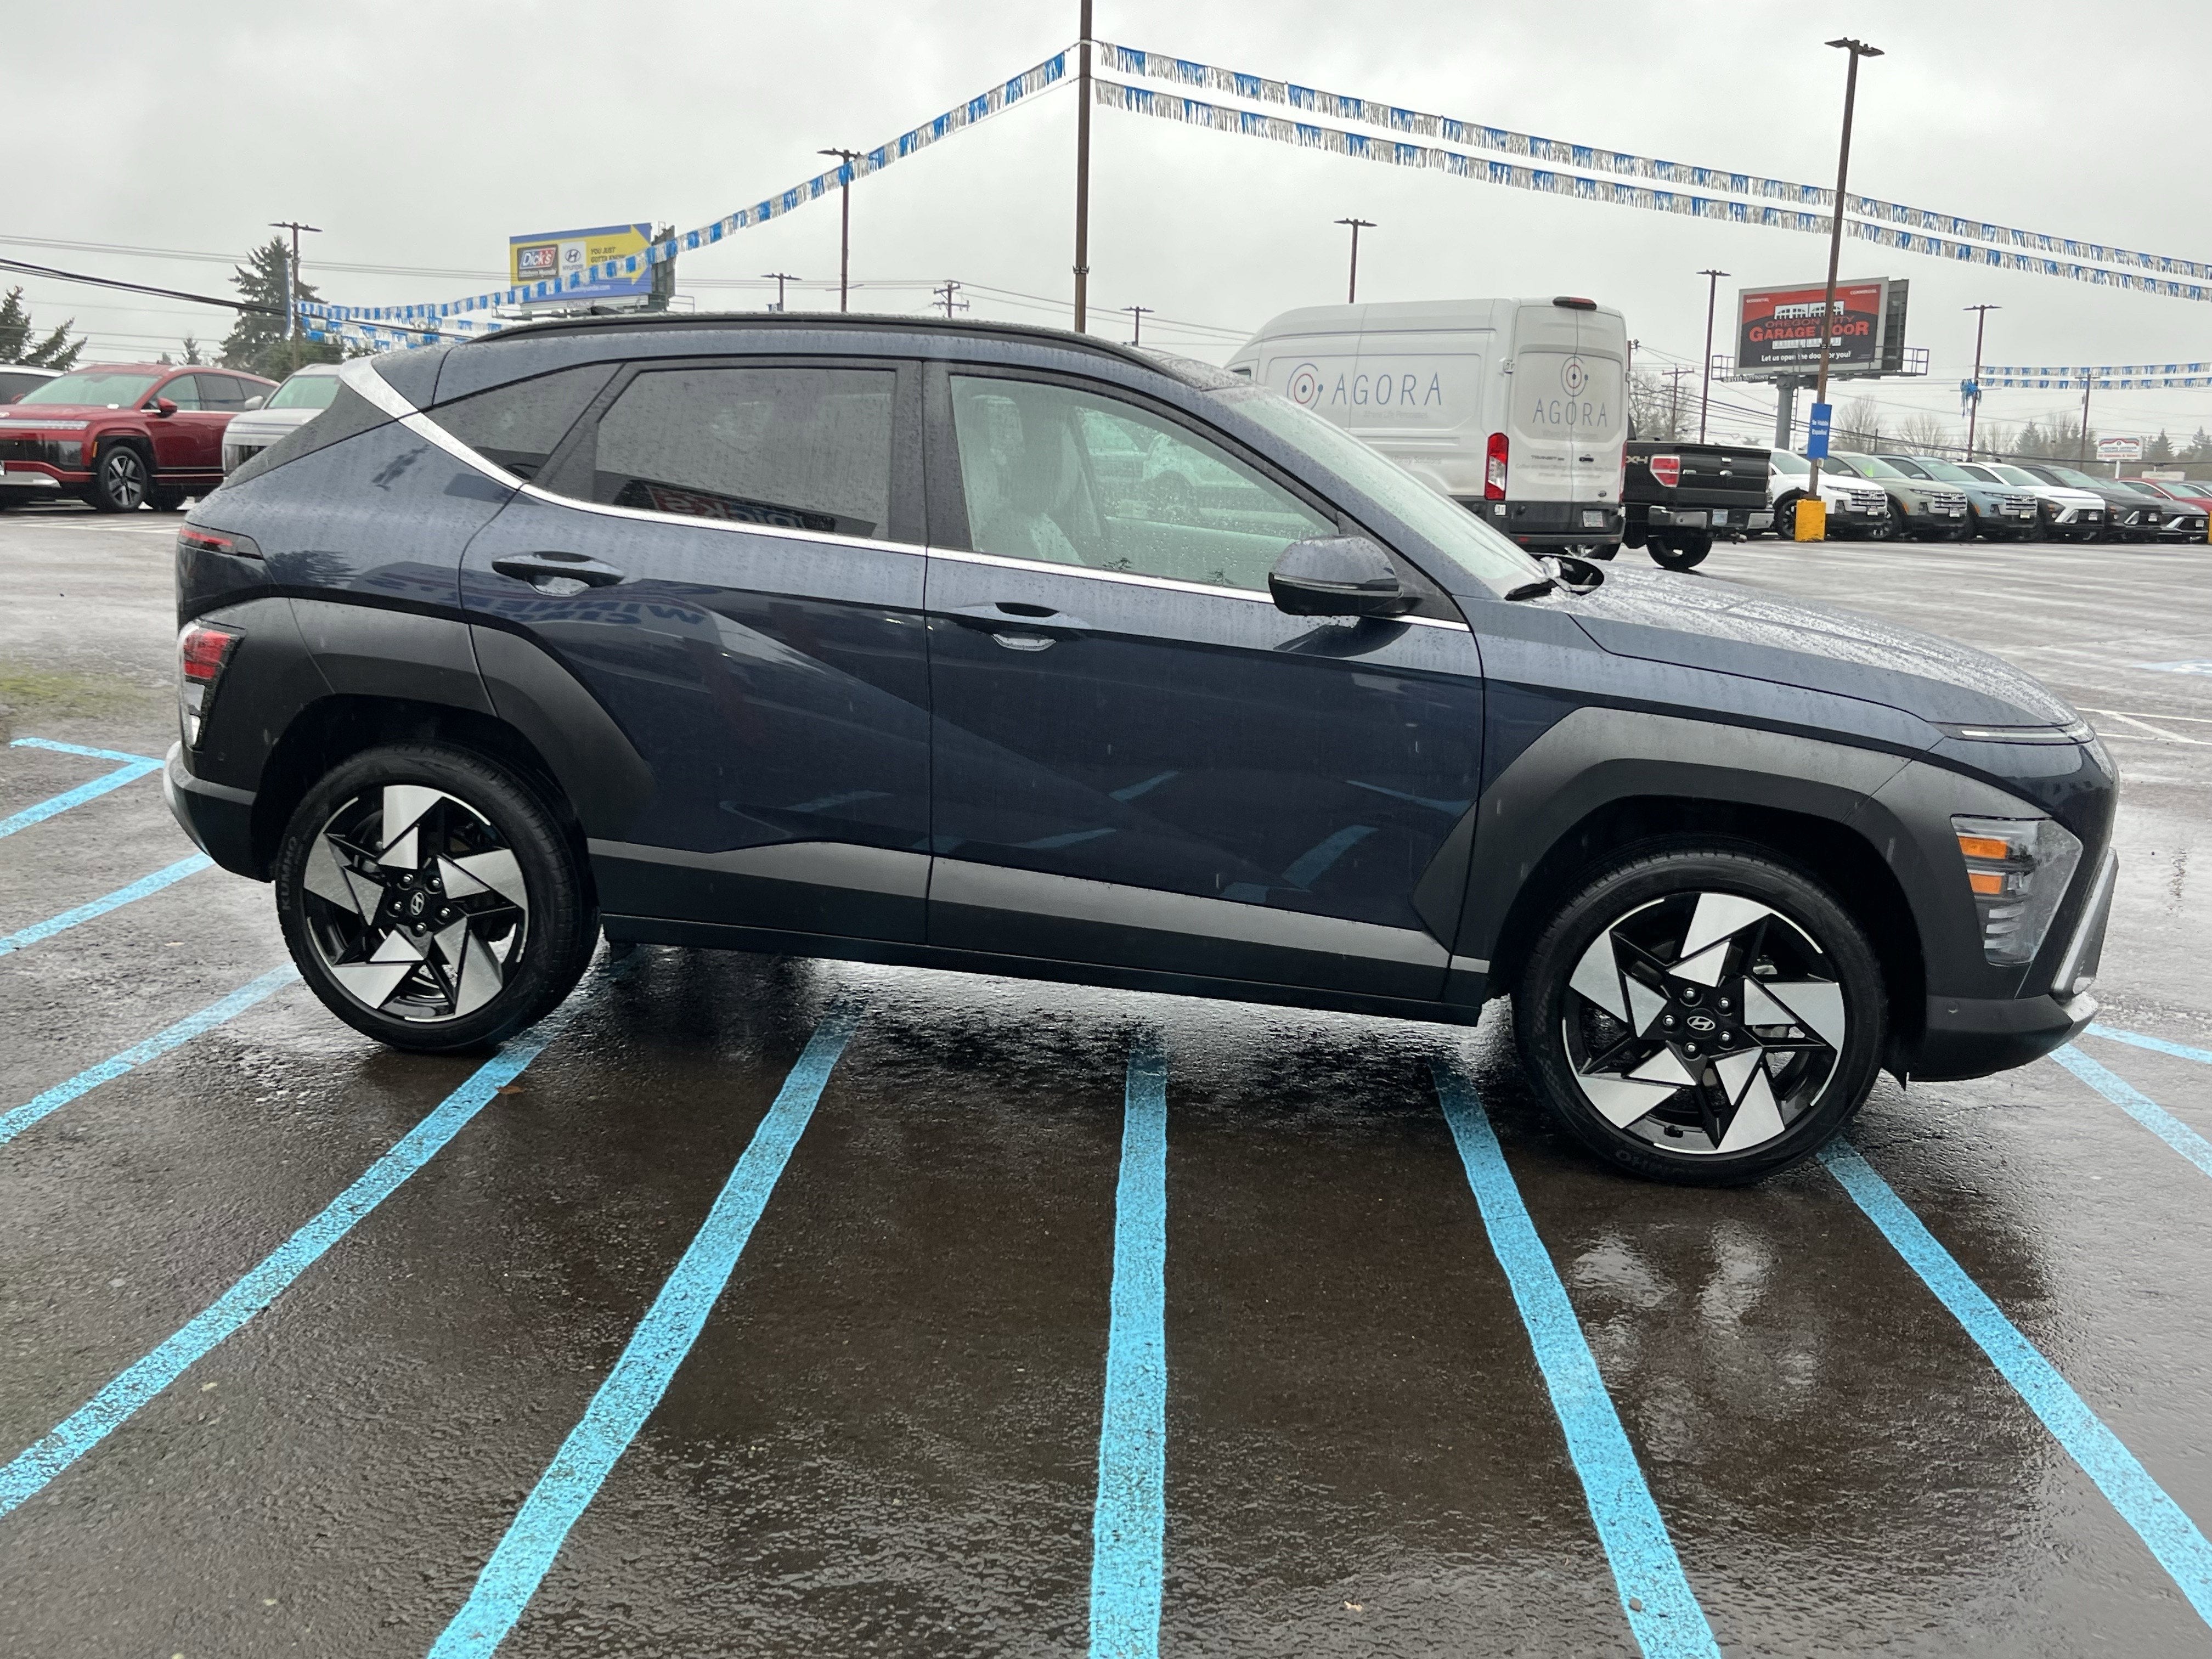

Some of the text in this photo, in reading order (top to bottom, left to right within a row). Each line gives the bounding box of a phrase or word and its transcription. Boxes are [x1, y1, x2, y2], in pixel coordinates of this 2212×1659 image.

[1750, 320, 1870, 342] GARAGE OOR
[1765, 315, 1855, 329] OREGON ITY
[1836, 351, 1850, 360] you!
[1331, 372, 1442, 405] AGORA
[1532, 398, 1607, 427] AGORA
